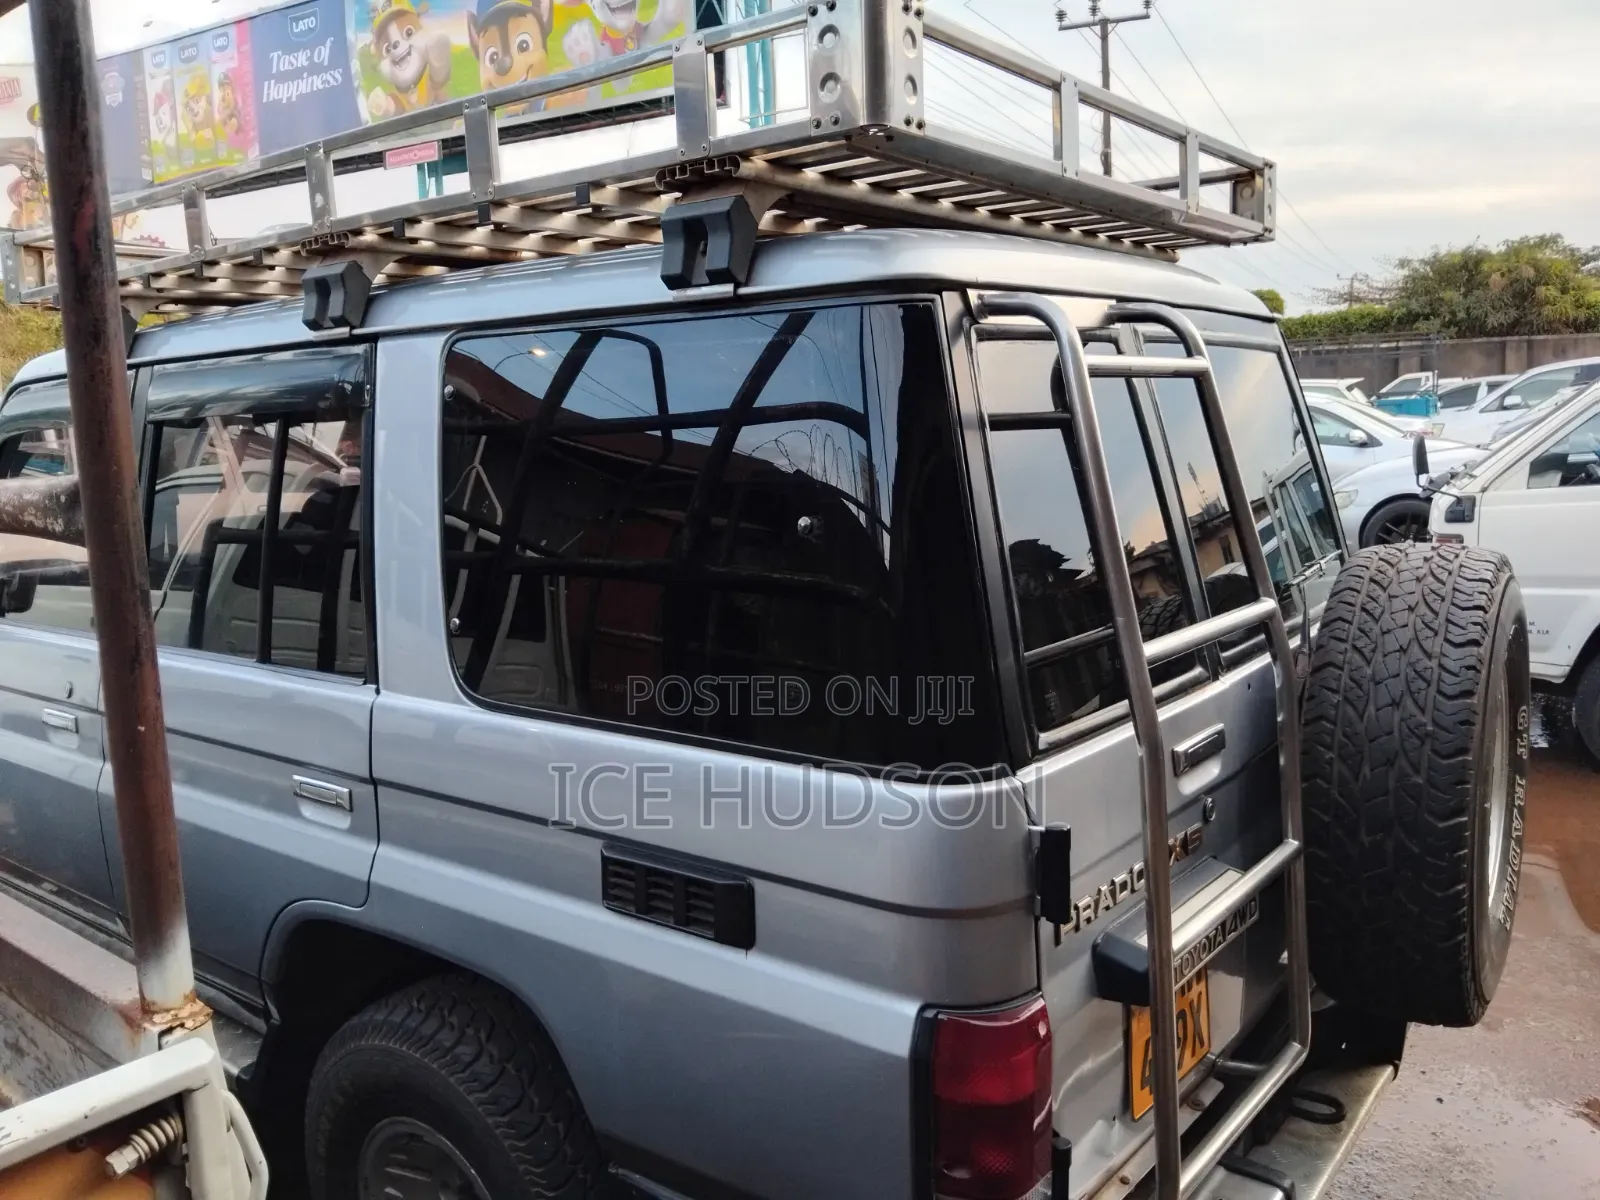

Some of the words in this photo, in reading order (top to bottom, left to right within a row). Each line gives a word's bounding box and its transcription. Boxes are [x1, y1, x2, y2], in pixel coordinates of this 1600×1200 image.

[213, 36, 228, 48] LATO
[292, 16, 316, 33] LATO
[152, 54, 165, 64] LATO
[180, 46, 198, 59] LATO
[269, 48, 311, 74] Taste
[313, 36, 334, 66] of
[262, 68, 343, 104] Happiness
[1516, 705, 1528, 759] GT
[1499, 774, 1526, 931] RADIAL
[1173, 925, 1224, 983] TOYOTA
